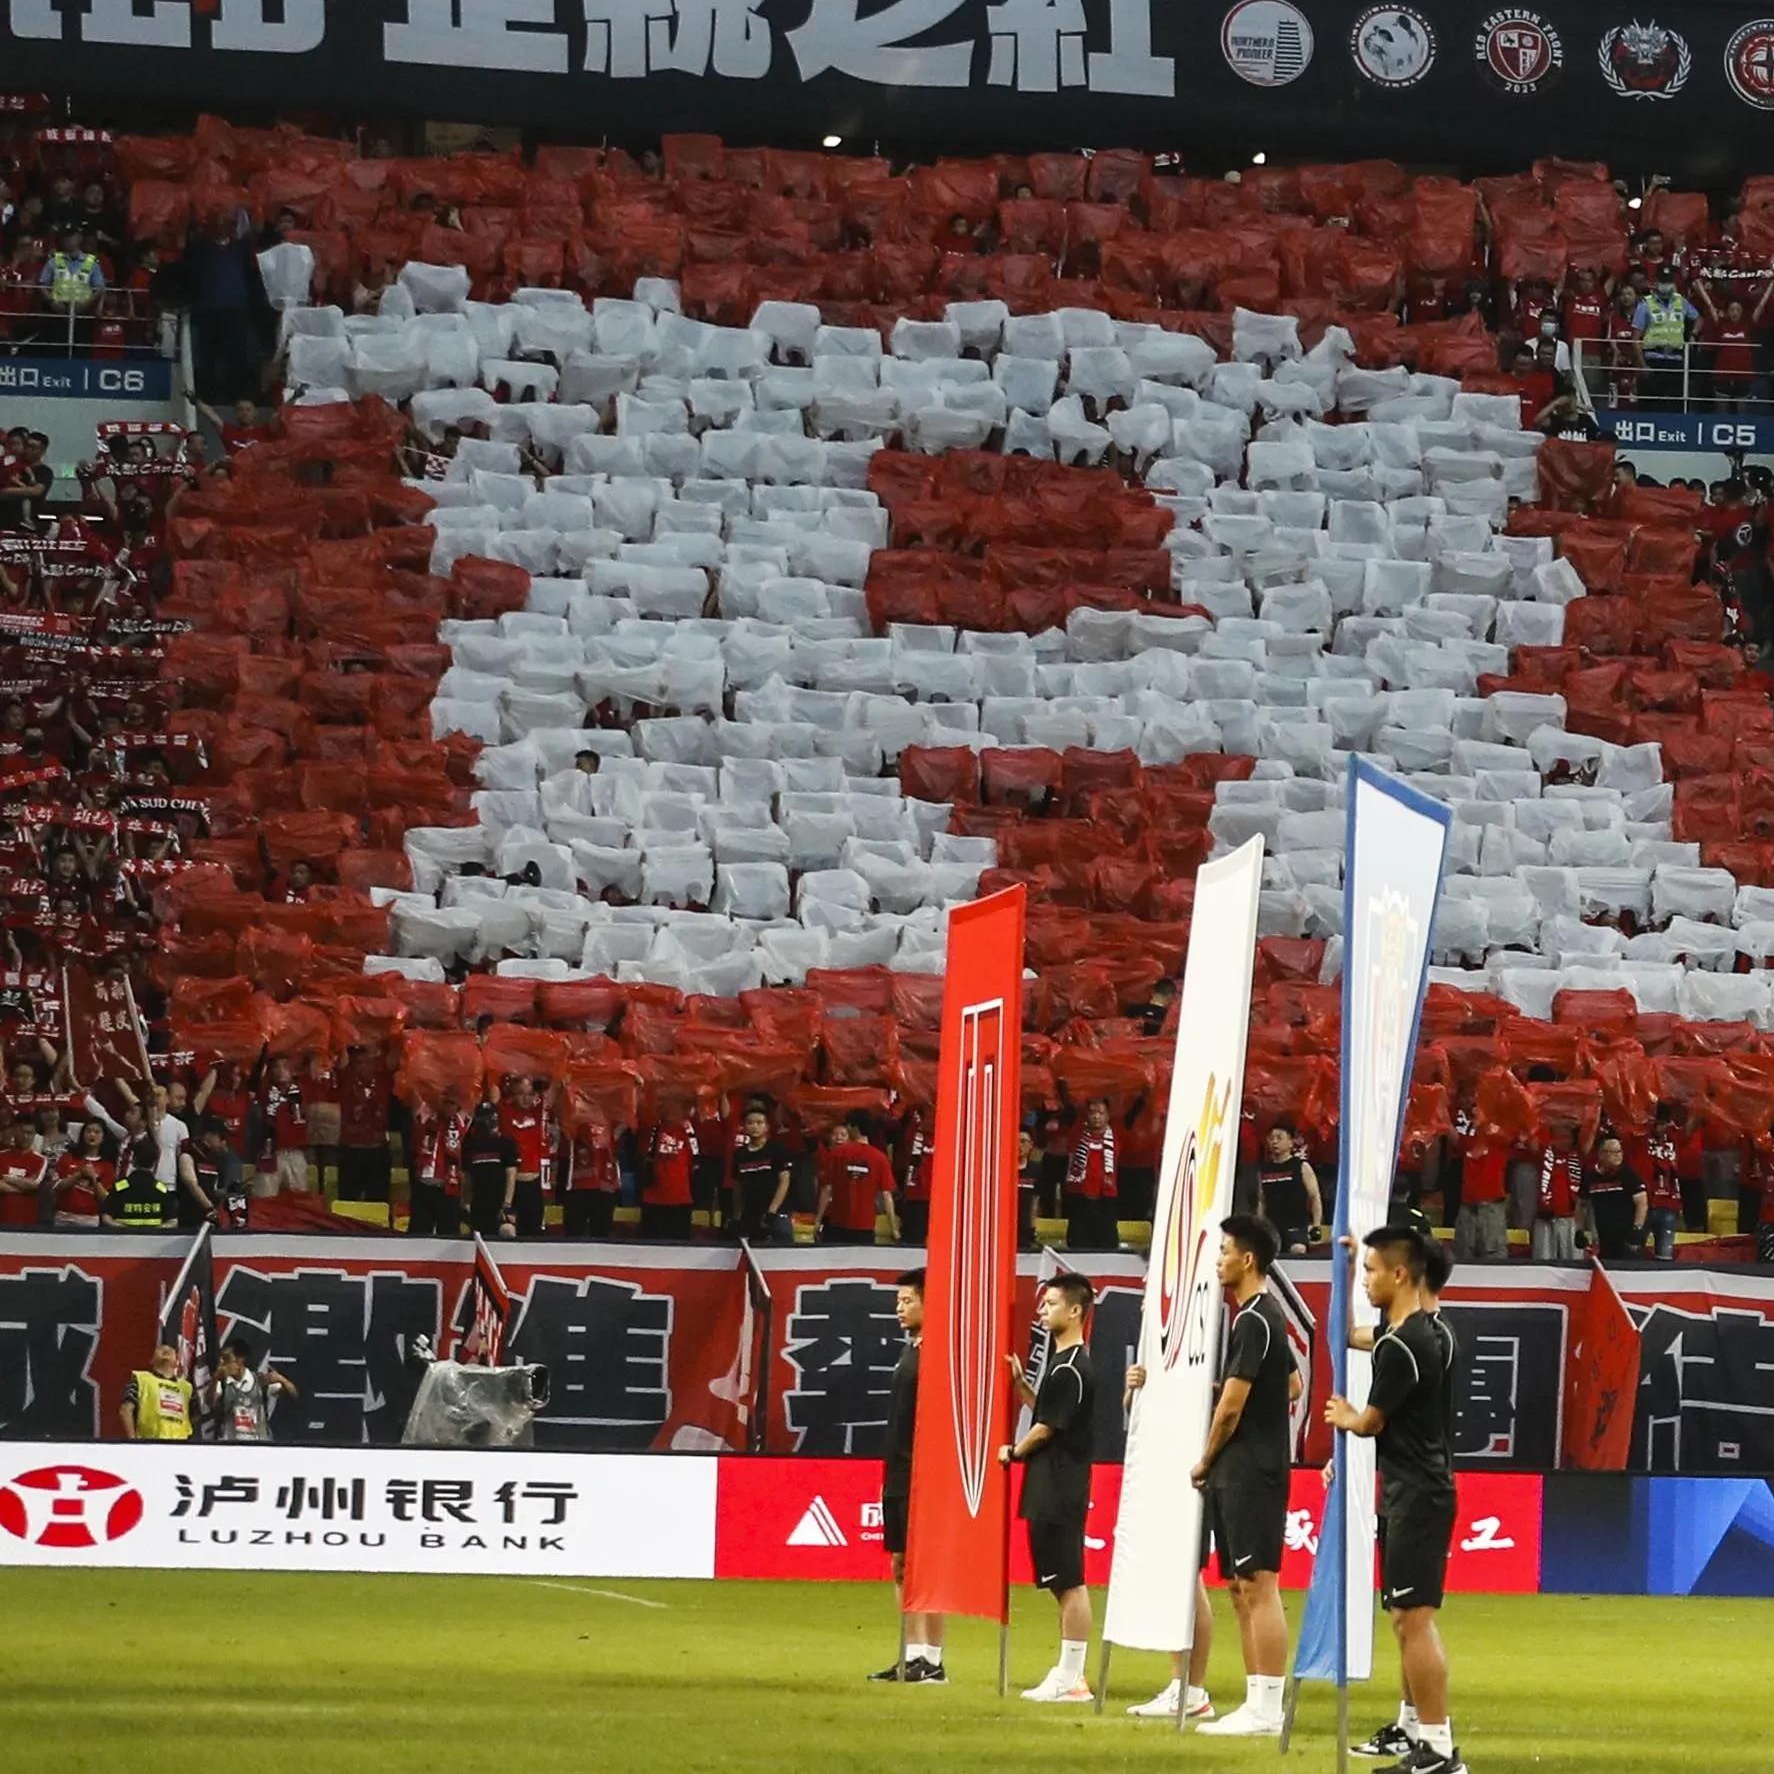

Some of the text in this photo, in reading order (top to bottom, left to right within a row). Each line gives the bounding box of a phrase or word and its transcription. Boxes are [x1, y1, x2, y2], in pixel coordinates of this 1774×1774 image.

[1474, 7, 1564, 69] RED EASTERN FRONT
[1236, 48, 1274, 60] PIONEER
[1503, 80, 1538, 94] 2023
[0, 366, 145, 392] 出口 Exit C6
[1616, 419, 1757, 447] 出口 Exit C5
[170, 1474, 579, 1527] 泸州银行
[178, 1528, 566, 1552] LUZHOU BANK
